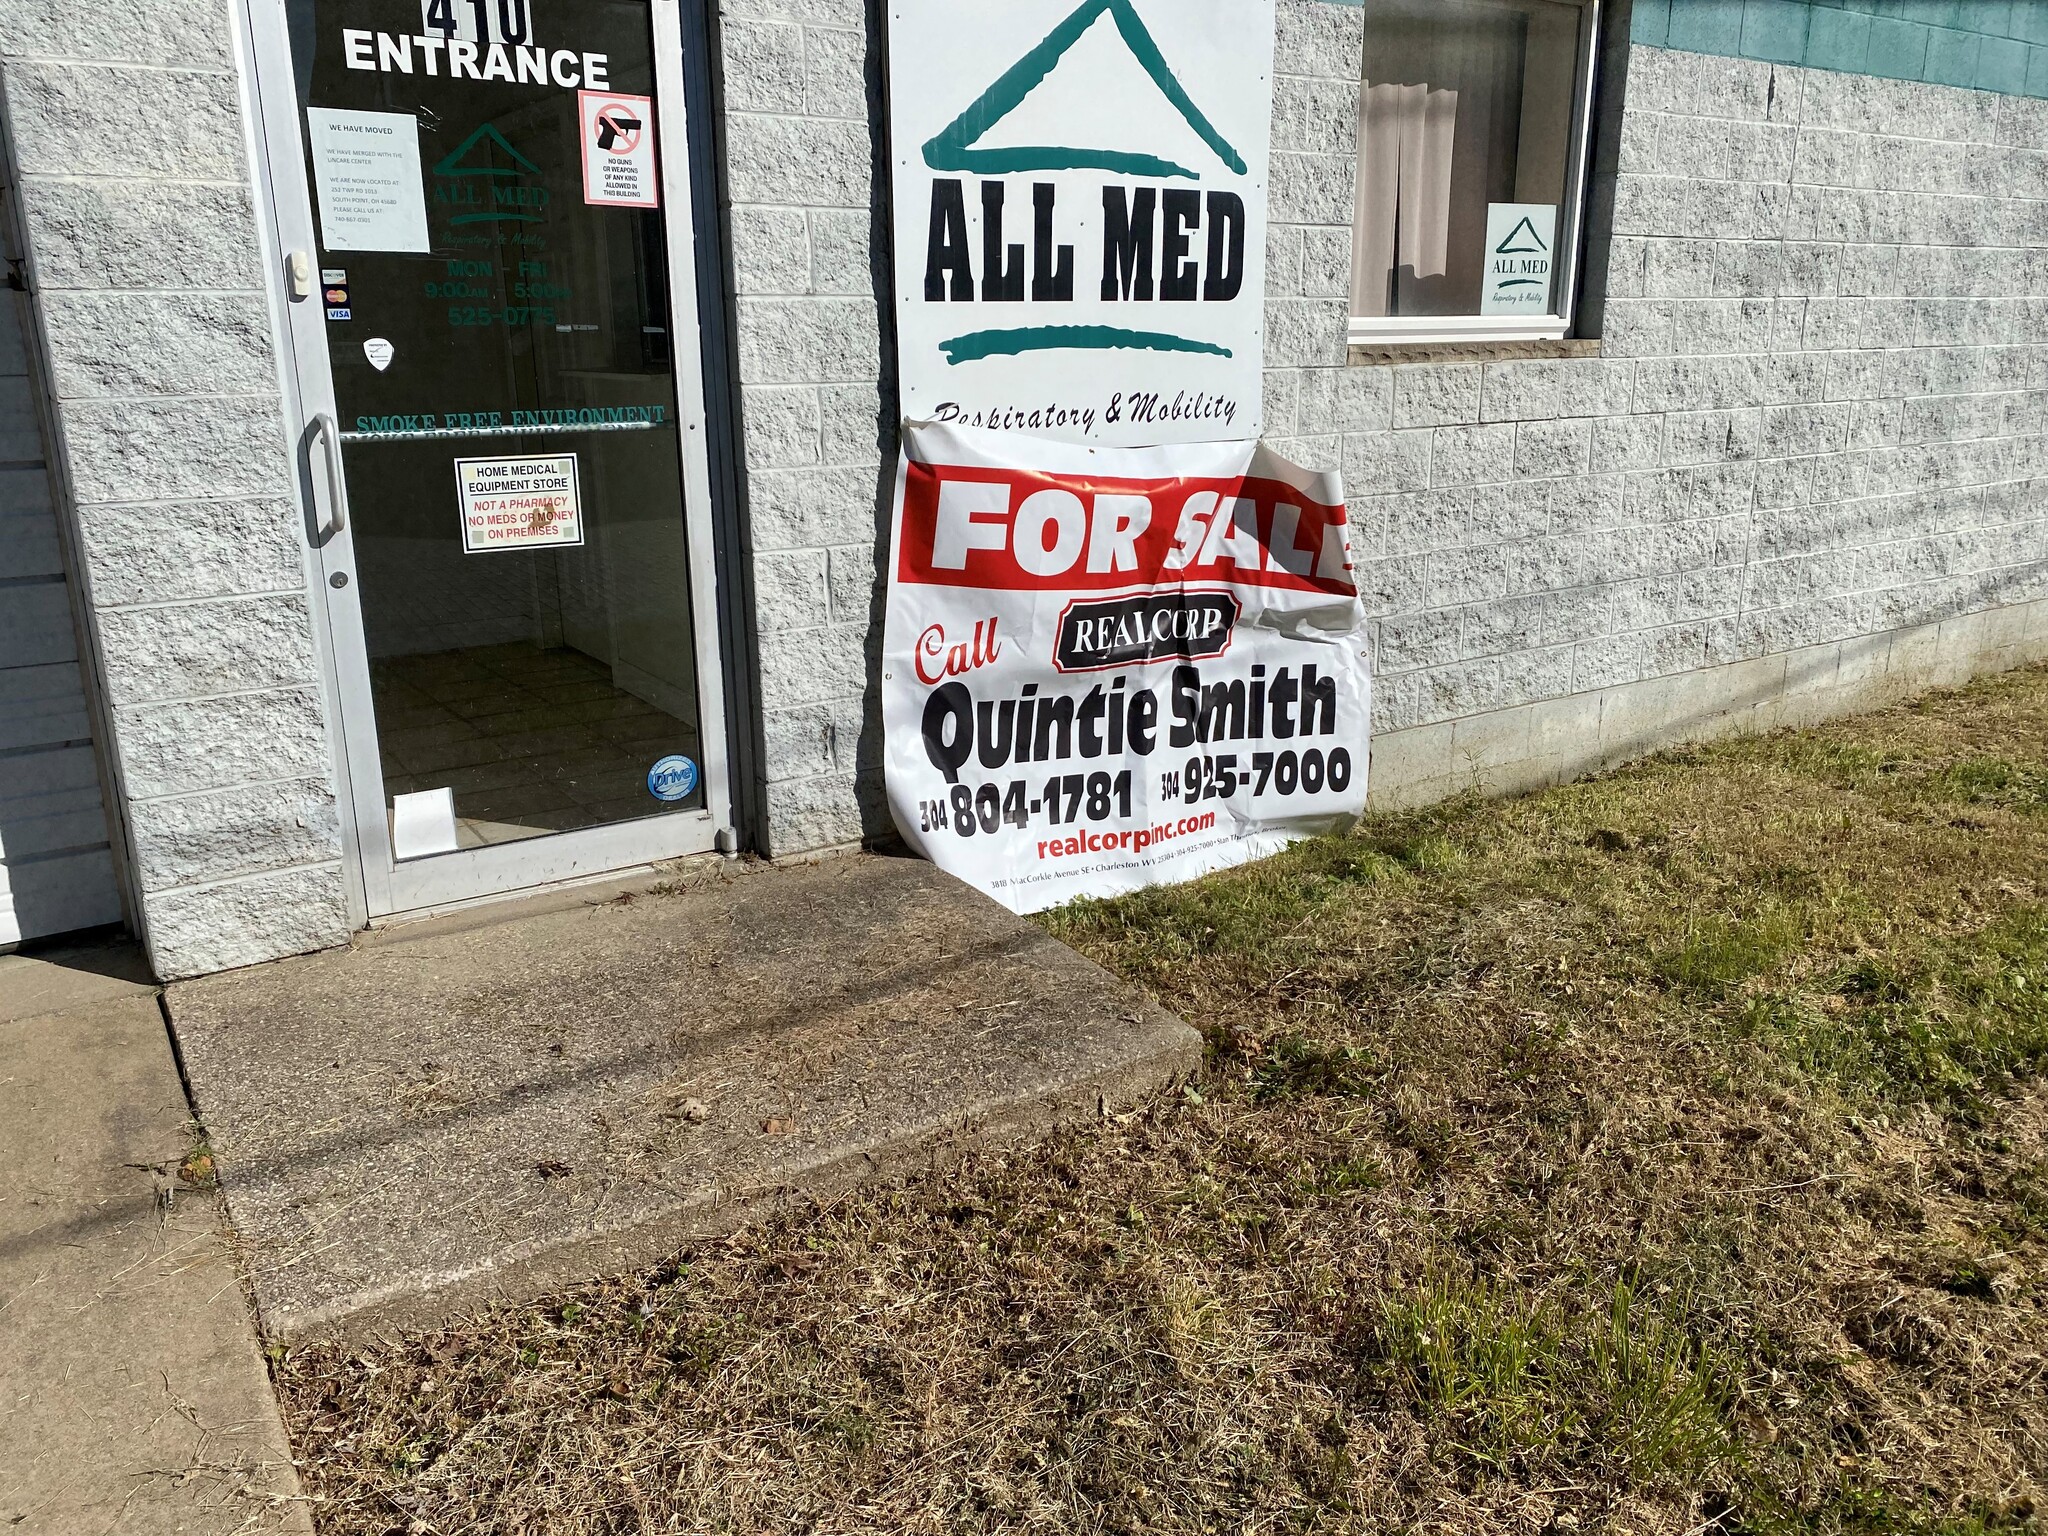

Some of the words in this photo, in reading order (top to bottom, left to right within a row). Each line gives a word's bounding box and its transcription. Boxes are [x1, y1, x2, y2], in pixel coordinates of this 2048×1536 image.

[426, 0, 527, 46] 410
[343, 28, 610, 91] ENTRANCE
[329, 124, 342, 132] WE
[343, 125, 364, 133] HAVE
[365, 126, 393, 135] MOVED
[611, 166, 638, 174] WEAPONS
[617, 158, 632, 166] GUNS
[433, 183, 482, 205] ALL
[492, 185, 550, 207] MED
[605, 182, 631, 190] ALLOWED
[616, 190, 641, 198] BUILDING
[924, 178, 1075, 302] ALL
[1100, 185, 1246, 302] MED
[447, 259, 493, 278] MON
[519, 260, 548, 278] FRI
[1492, 259, 1516, 274] ALL
[1520, 259, 1548, 274] MED
[330, 310, 350, 318] VISA
[447, 305, 556, 327] 525-0775
[1105, 391, 1122, 424] &
[1128, 390, 1237, 427] Mobility
[356, 414, 437, 434] SMOKE
[444, 411, 502, 430] FREE
[511, 405, 666, 427] ENVIRONMENT
[477, 466, 509, 477] HOME
[511, 464, 558, 476] MEDICAL
[469, 480, 530, 493] EQUIPMENT
[533, 478, 568, 490] STORE
[474, 500, 496, 511] NOT
[499, 500, 506, 510] A
[509, 496, 568, 510] PHARMACY
[469, 515, 484, 526] NO
[487, 513, 517, 525] MEDS
[520, 512, 535, 523] OR
[538, 510, 574, 522] MONEY
[931, 480, 1152, 577] FOR
[488, 529, 504, 539] ON
[506, 525, 559, 538] PREMISES
[1071, 607, 1222, 653] REALCORP
[914, 616, 1002, 685] Call
[921, 675, 1157, 784] Quintie
[1169, 664, 1336, 749] Smith
[654, 767, 693, 788] Drive
[919, 800, 949, 833] 304
[952, 769, 1132, 838] 804-1781
[1161, 772, 1180, 802] 304
[1183, 747, 1351, 805] 925-7000
[1037, 811, 1215, 860] realcorpinc.com
[991, 879, 1008, 889] 3818
[1009, 873, 1052, 886] MacCorkle
[1053, 868, 1080, 879] Avenue
[1081, 865, 1090, 875] SE
[1095, 861, 1139, 873] Charleston
[1141, 858, 1156, 867] WV
